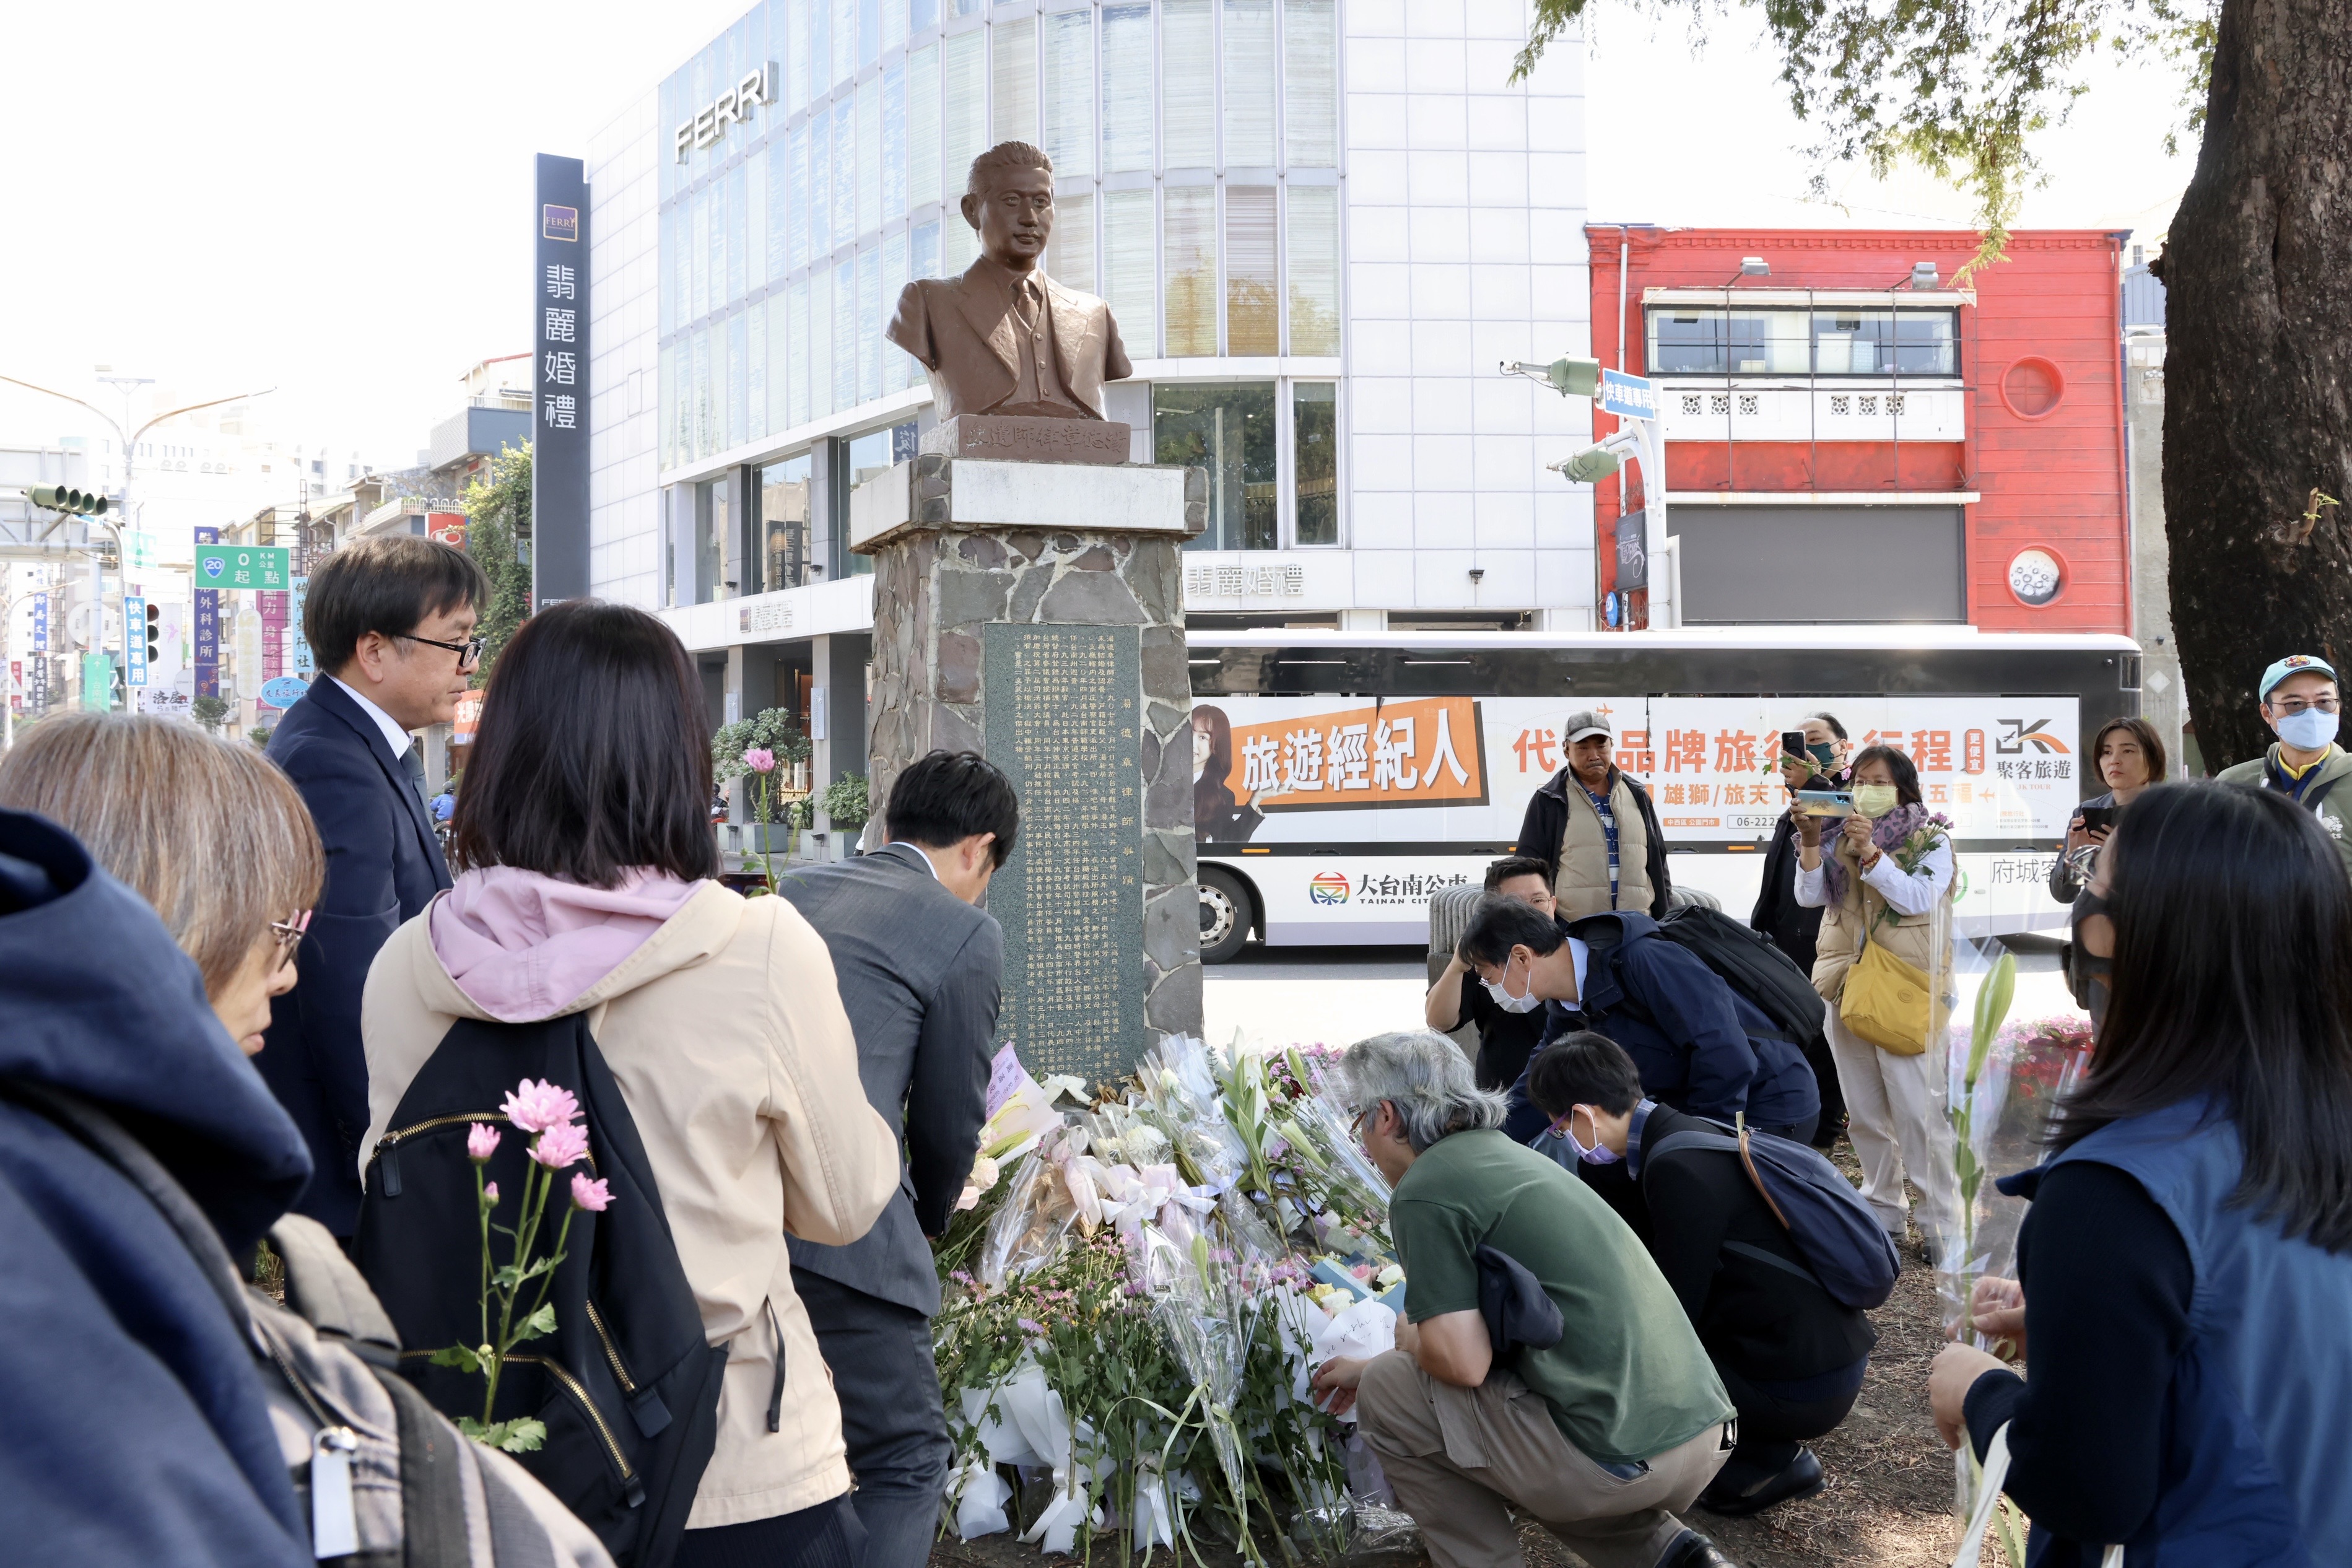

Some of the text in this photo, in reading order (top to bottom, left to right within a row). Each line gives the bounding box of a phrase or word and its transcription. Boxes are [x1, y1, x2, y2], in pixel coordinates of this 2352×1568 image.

[675, 61, 779, 165] FERRI
[546, 216, 575, 227] FERRI
[545, 264, 576, 429] 翡麗婚禮
[1606, 380, 1652, 409] 快車道專用
[206, 560, 222, 570] 20
[238, 553, 250, 566] 0
[259, 560, 274, 568] 公里
[1188, 564, 1304, 596] 翡麗婚禮
[128, 600, 144, 683] 快車道專用
[1242, 708, 1468, 792] 旅遊經紀人
[1969, 733, 1980, 770] 更便宜
[1997, 760, 2071, 780] 聚客旅遊
